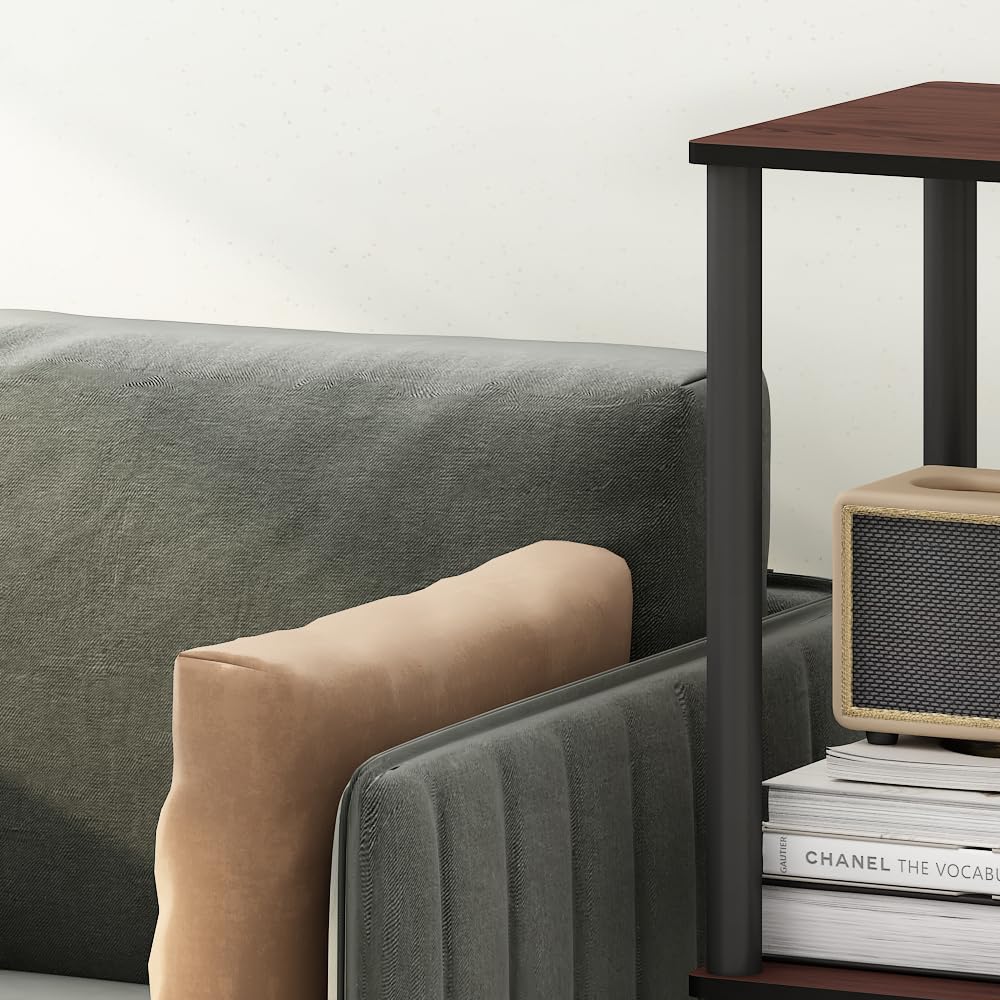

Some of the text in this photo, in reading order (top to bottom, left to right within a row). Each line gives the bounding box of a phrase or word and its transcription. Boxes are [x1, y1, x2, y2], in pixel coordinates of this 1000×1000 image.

[780, 836, 788, 873] GAUTIER
[805, 850, 891, 871] CHANEL
[898, 859, 929, 875] THE
